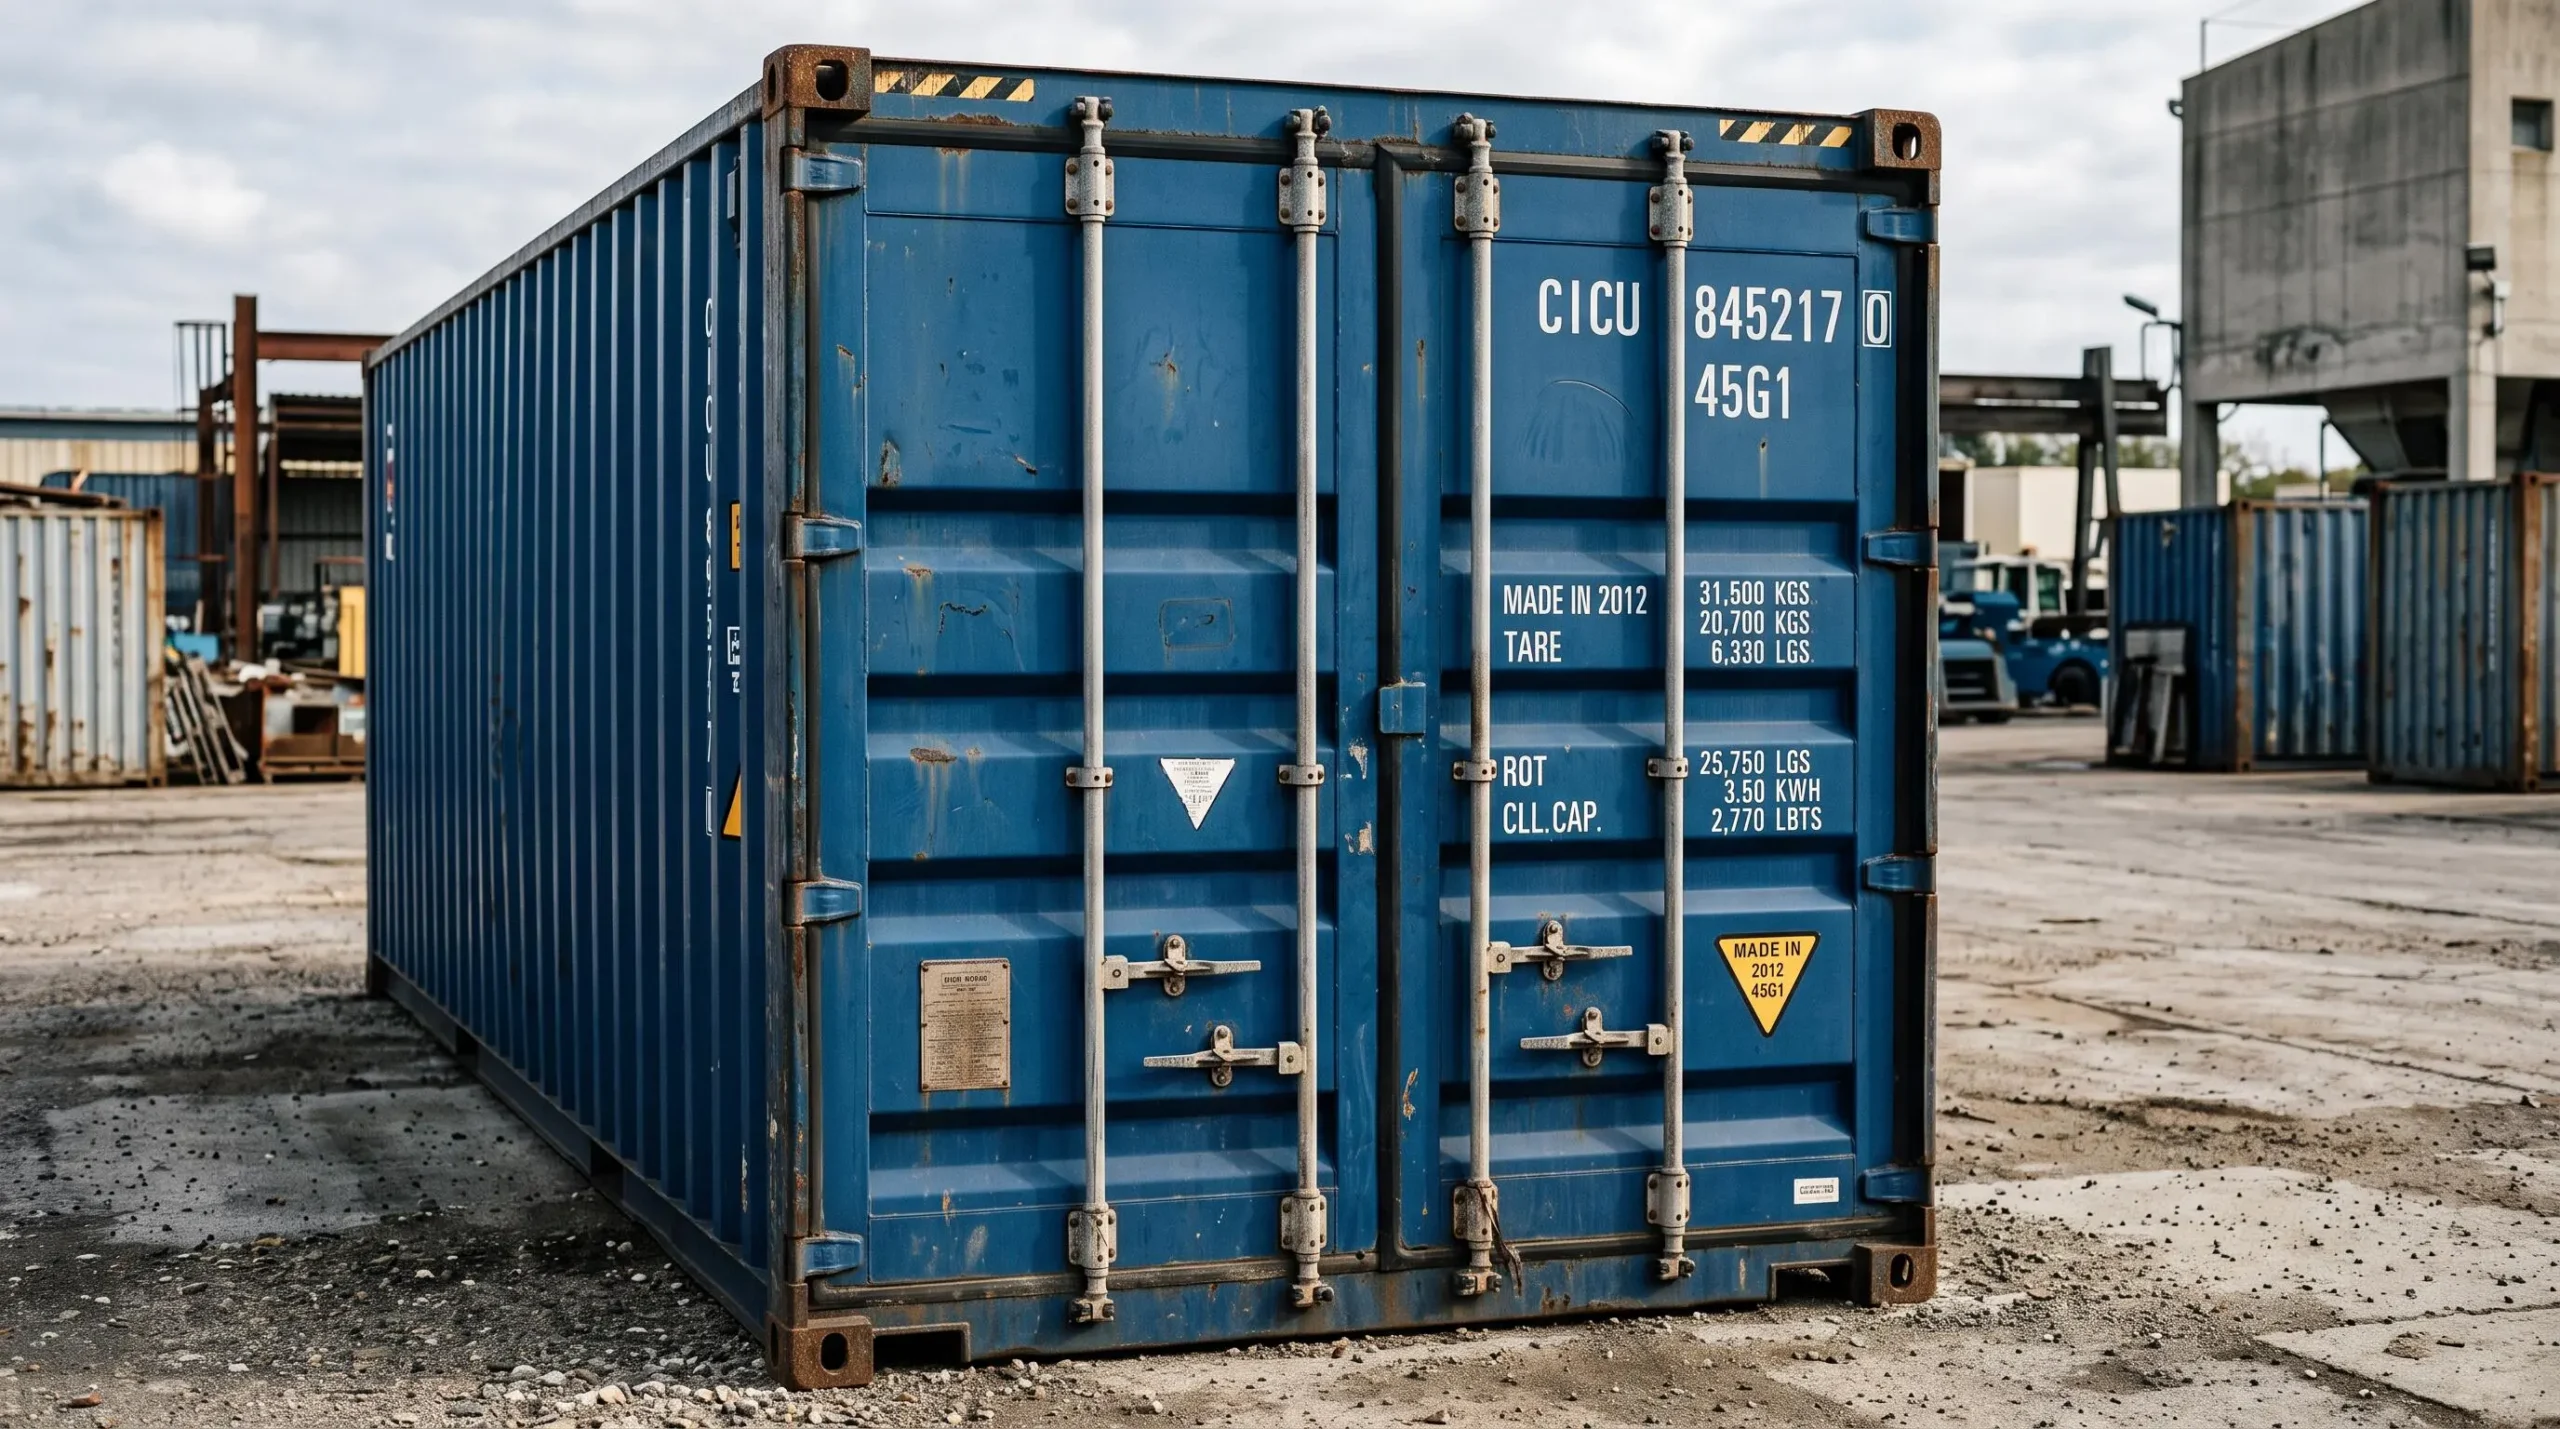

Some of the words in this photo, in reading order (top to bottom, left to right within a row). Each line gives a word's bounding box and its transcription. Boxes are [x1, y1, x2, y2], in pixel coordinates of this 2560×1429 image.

[1538, 278, 1640, 337] CICU
[1694, 284, 1843, 343] 845217
[1694, 363, 1790, 419] 45G1
[1503, 584, 1564, 615] MADE
[1571, 585, 1591, 615] IN
[1598, 585, 1647, 615] 2012
[1699, 580, 1765, 607] 31,500
[1700, 610, 1765, 637] 20,700
[1503, 630, 1562, 663] TARE
[1711, 639, 1765, 667] 6,330
[1503, 755, 1548, 787] ROT
[1700, 750, 1765, 779] 25,750
[1776, 749, 1811, 774] LGS
[1724, 778, 1765, 804] 3.50
[1776, 778, 1820, 803] KWH
[1711, 807, 1765, 836] 2,770
[1776, 806, 1822, 831] LBTS
[1734, 942, 1780, 958] MADE
[1785, 941, 1801, 956] IN
[1751, 962, 1784, 978] 2012
[1751, 982, 1784, 998] 45G1
